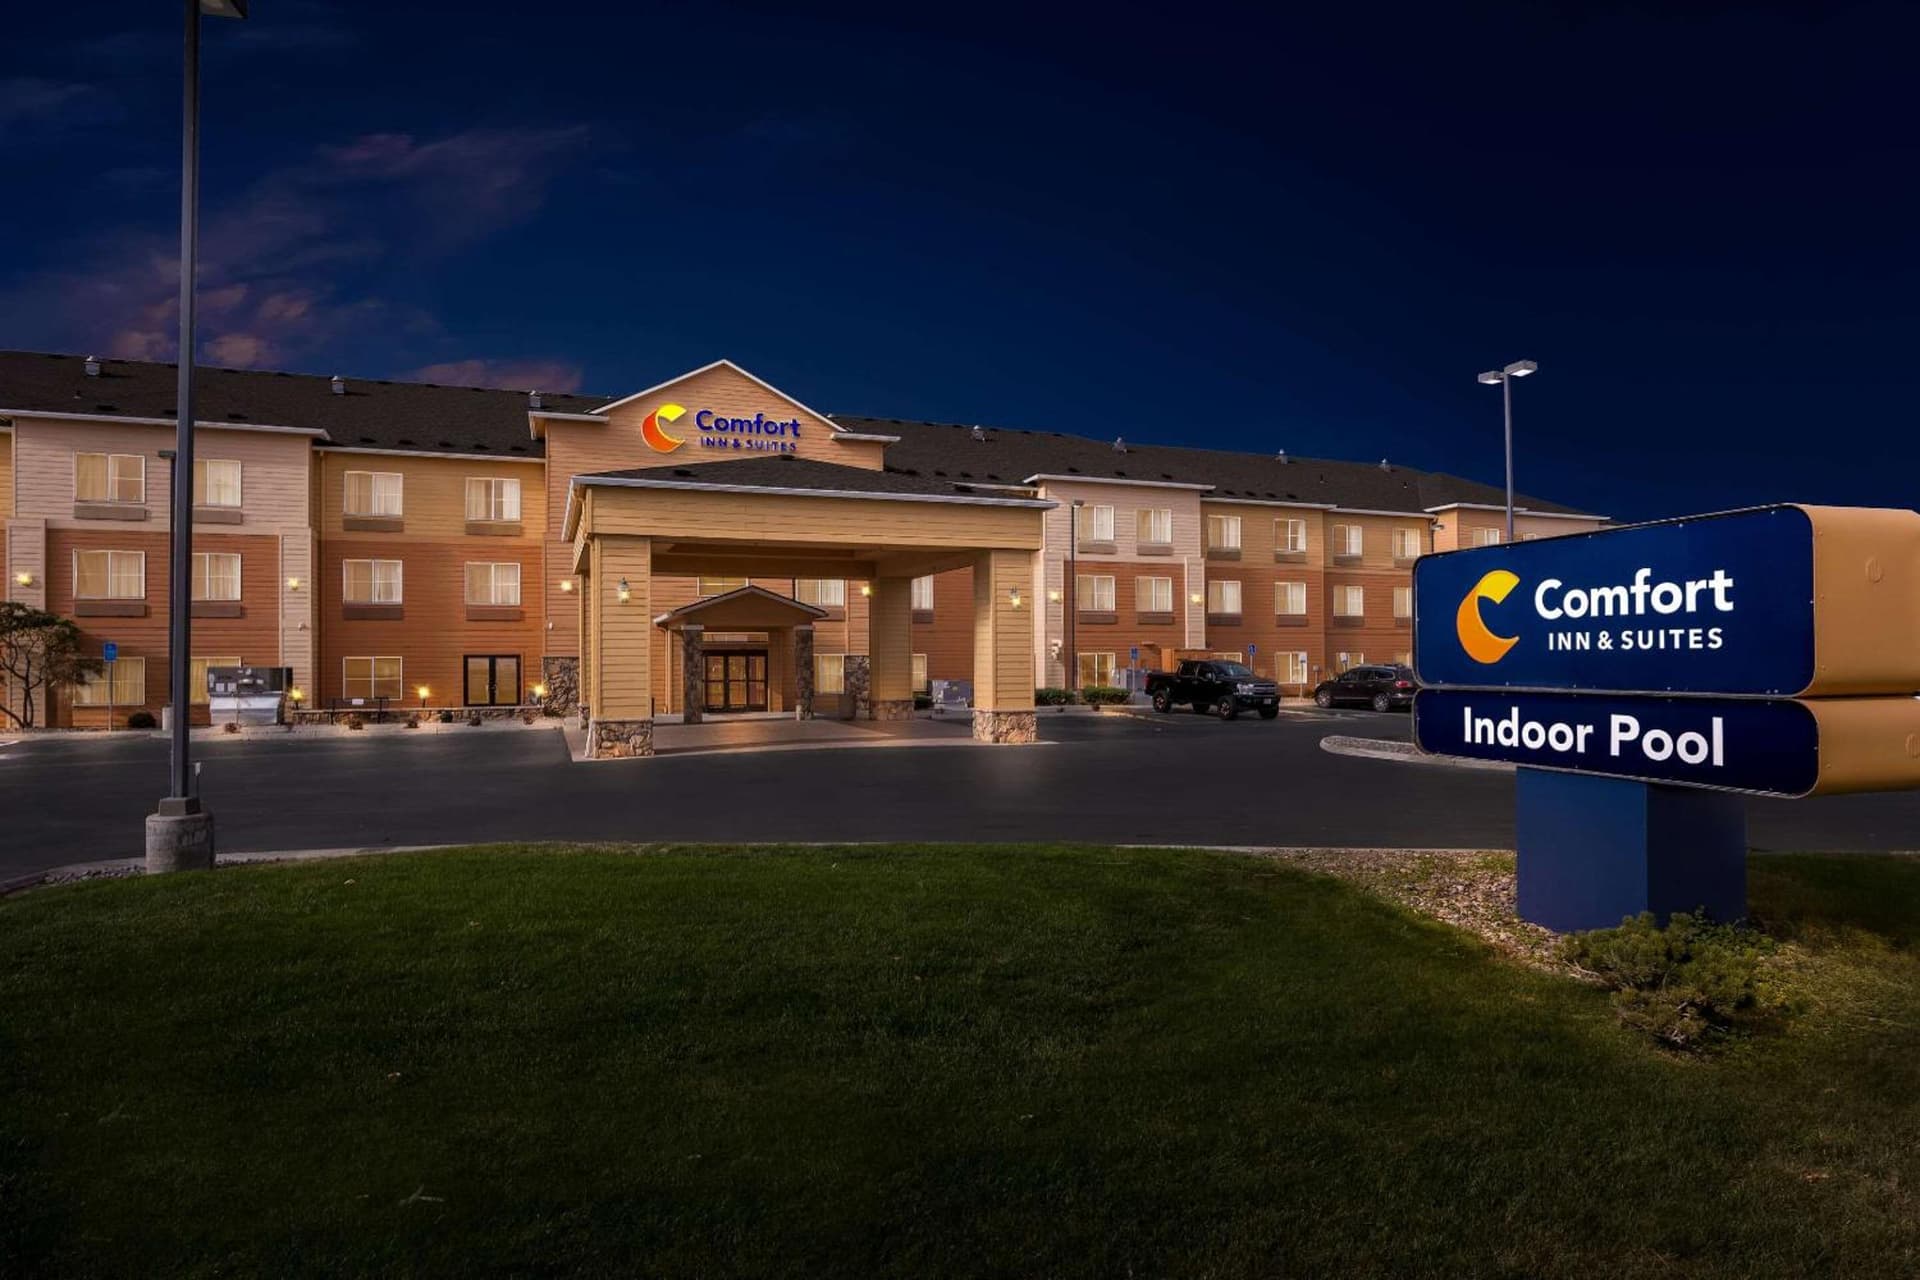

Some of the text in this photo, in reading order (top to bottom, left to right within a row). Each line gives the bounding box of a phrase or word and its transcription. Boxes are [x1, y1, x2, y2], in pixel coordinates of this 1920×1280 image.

[696, 410, 801, 437] Comfort
[701, 436, 797, 452] INN & SUITES
[1534, 567, 1734, 620] Comfort
[1548, 628, 1723, 651] INN & SUITES
[1463, 706, 1724, 767] Indoor Pool
